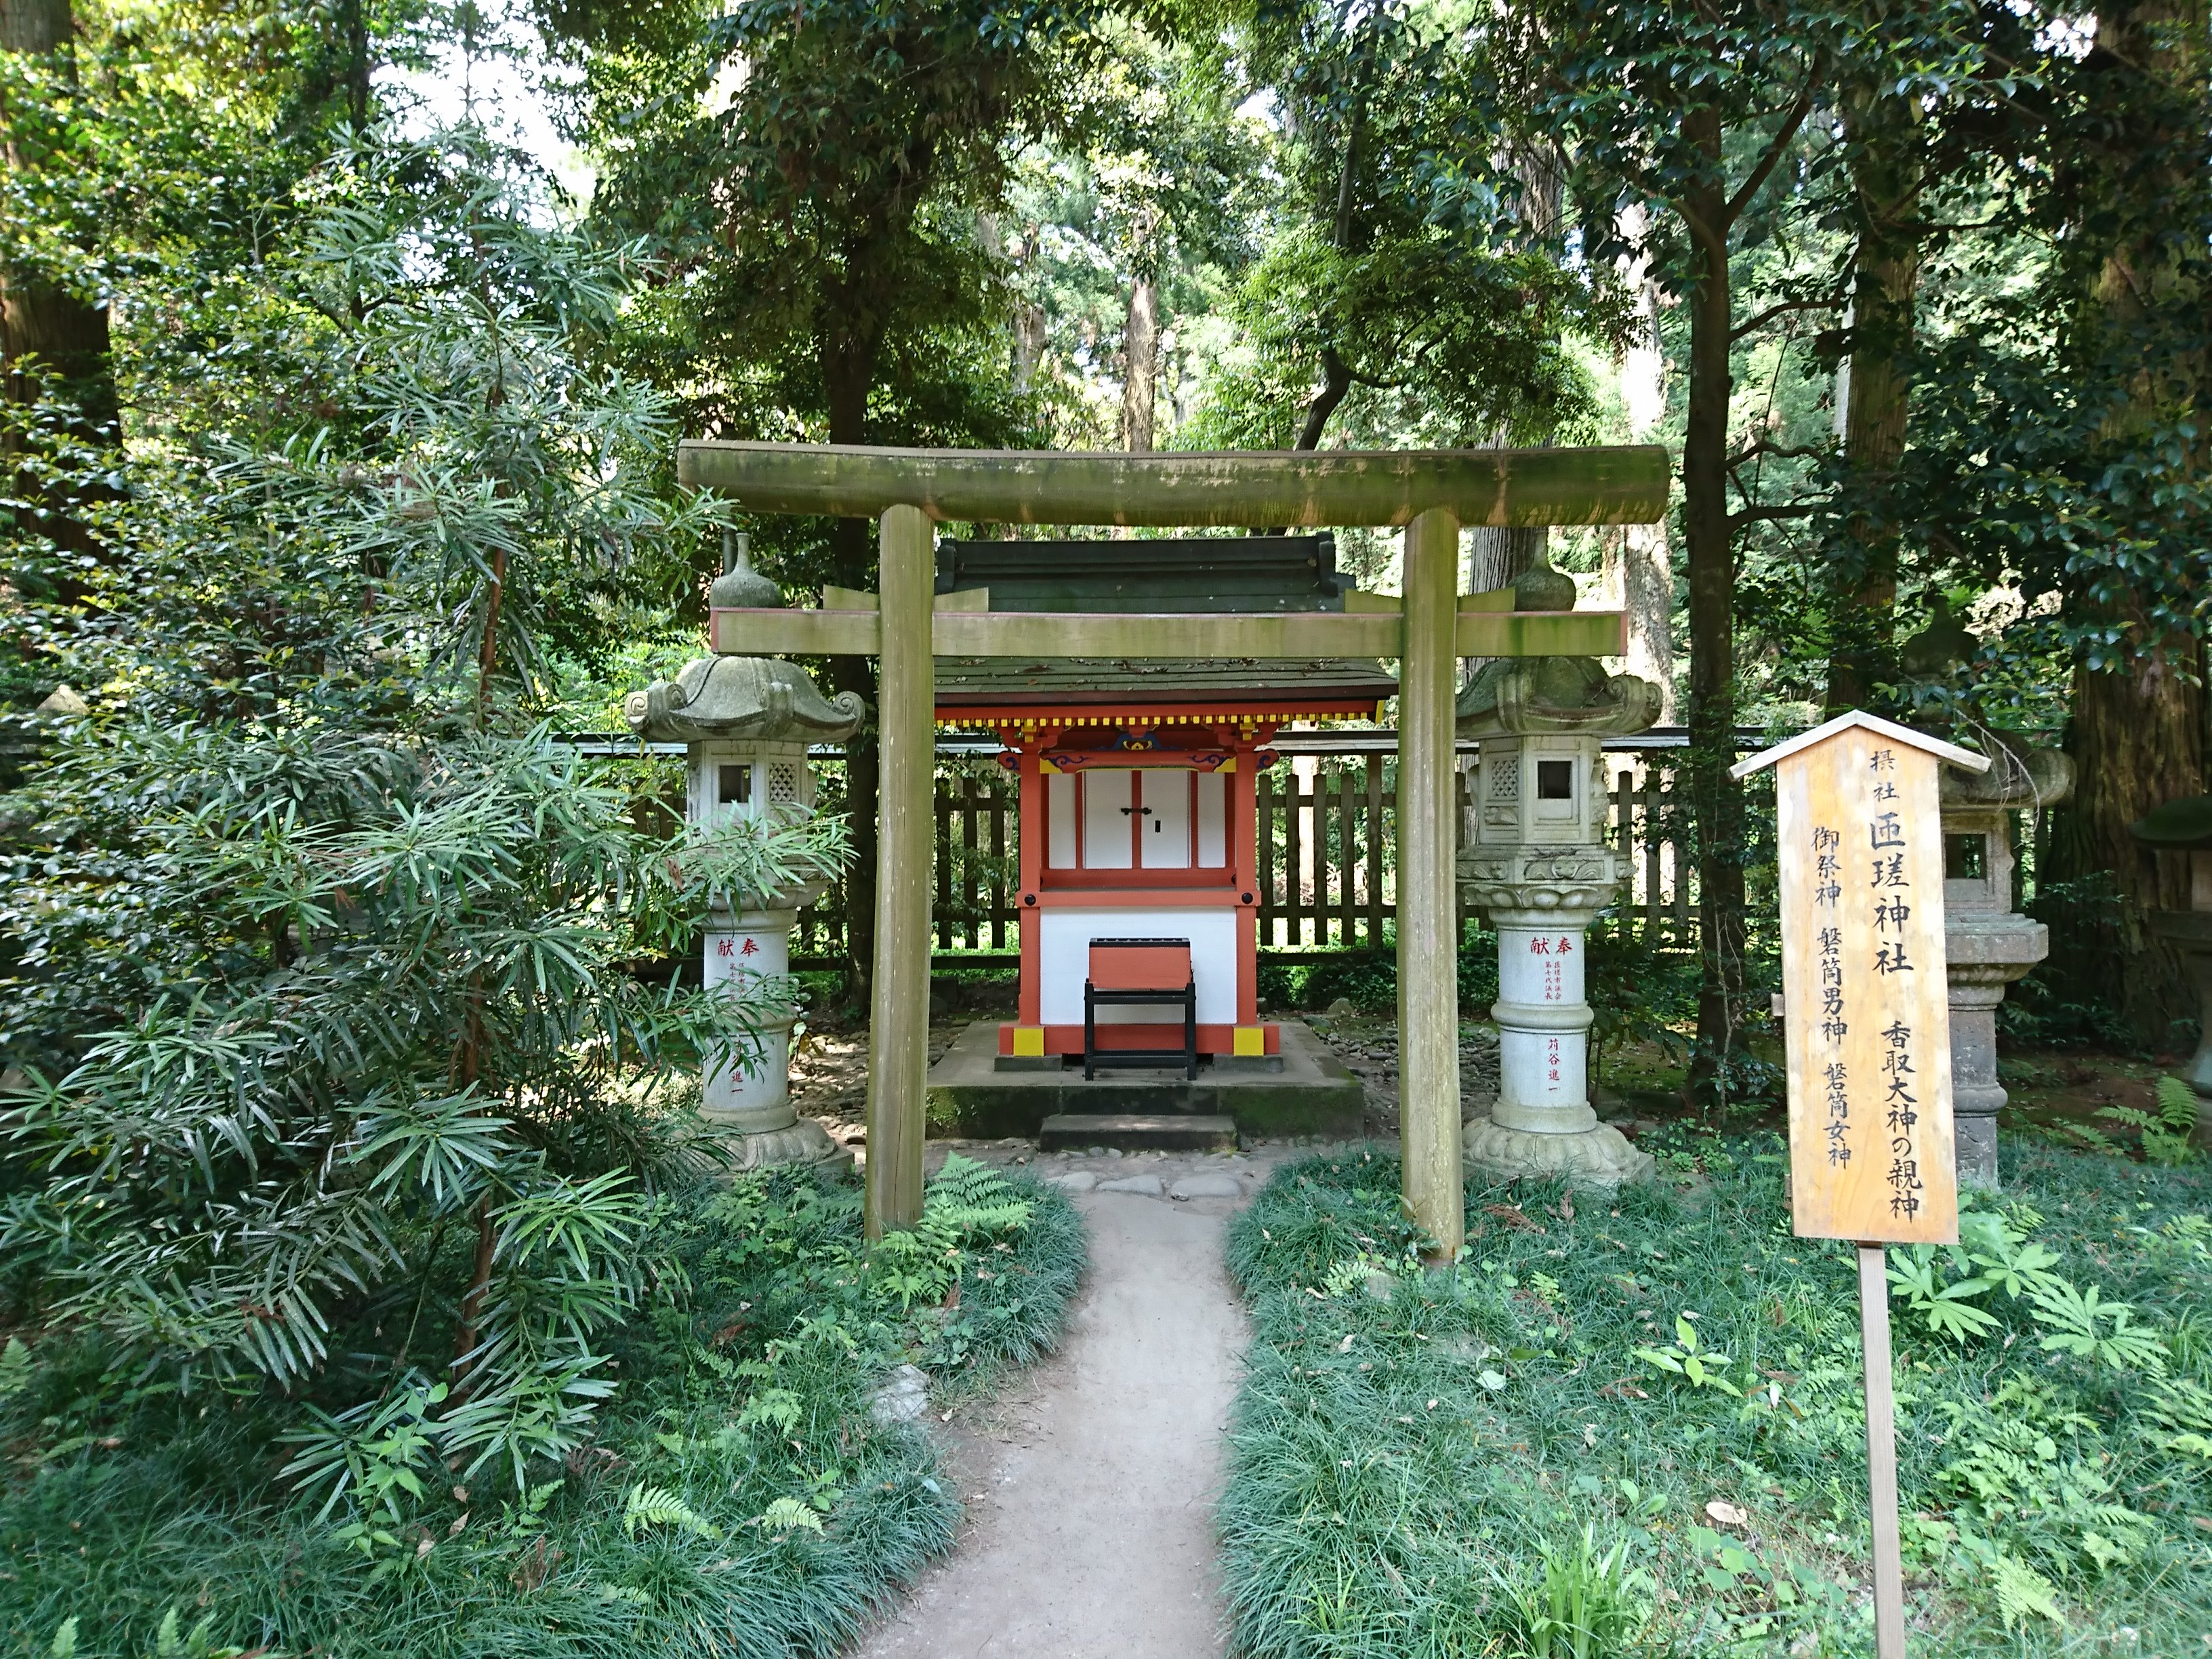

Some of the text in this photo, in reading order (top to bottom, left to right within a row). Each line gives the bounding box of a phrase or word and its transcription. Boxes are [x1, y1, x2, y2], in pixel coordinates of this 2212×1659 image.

[1810, 826, 1852, 1170] 御祭神 磐筒男神 磐筒女神
[1881, 1020, 1923, 1224] 香取大神の親神
